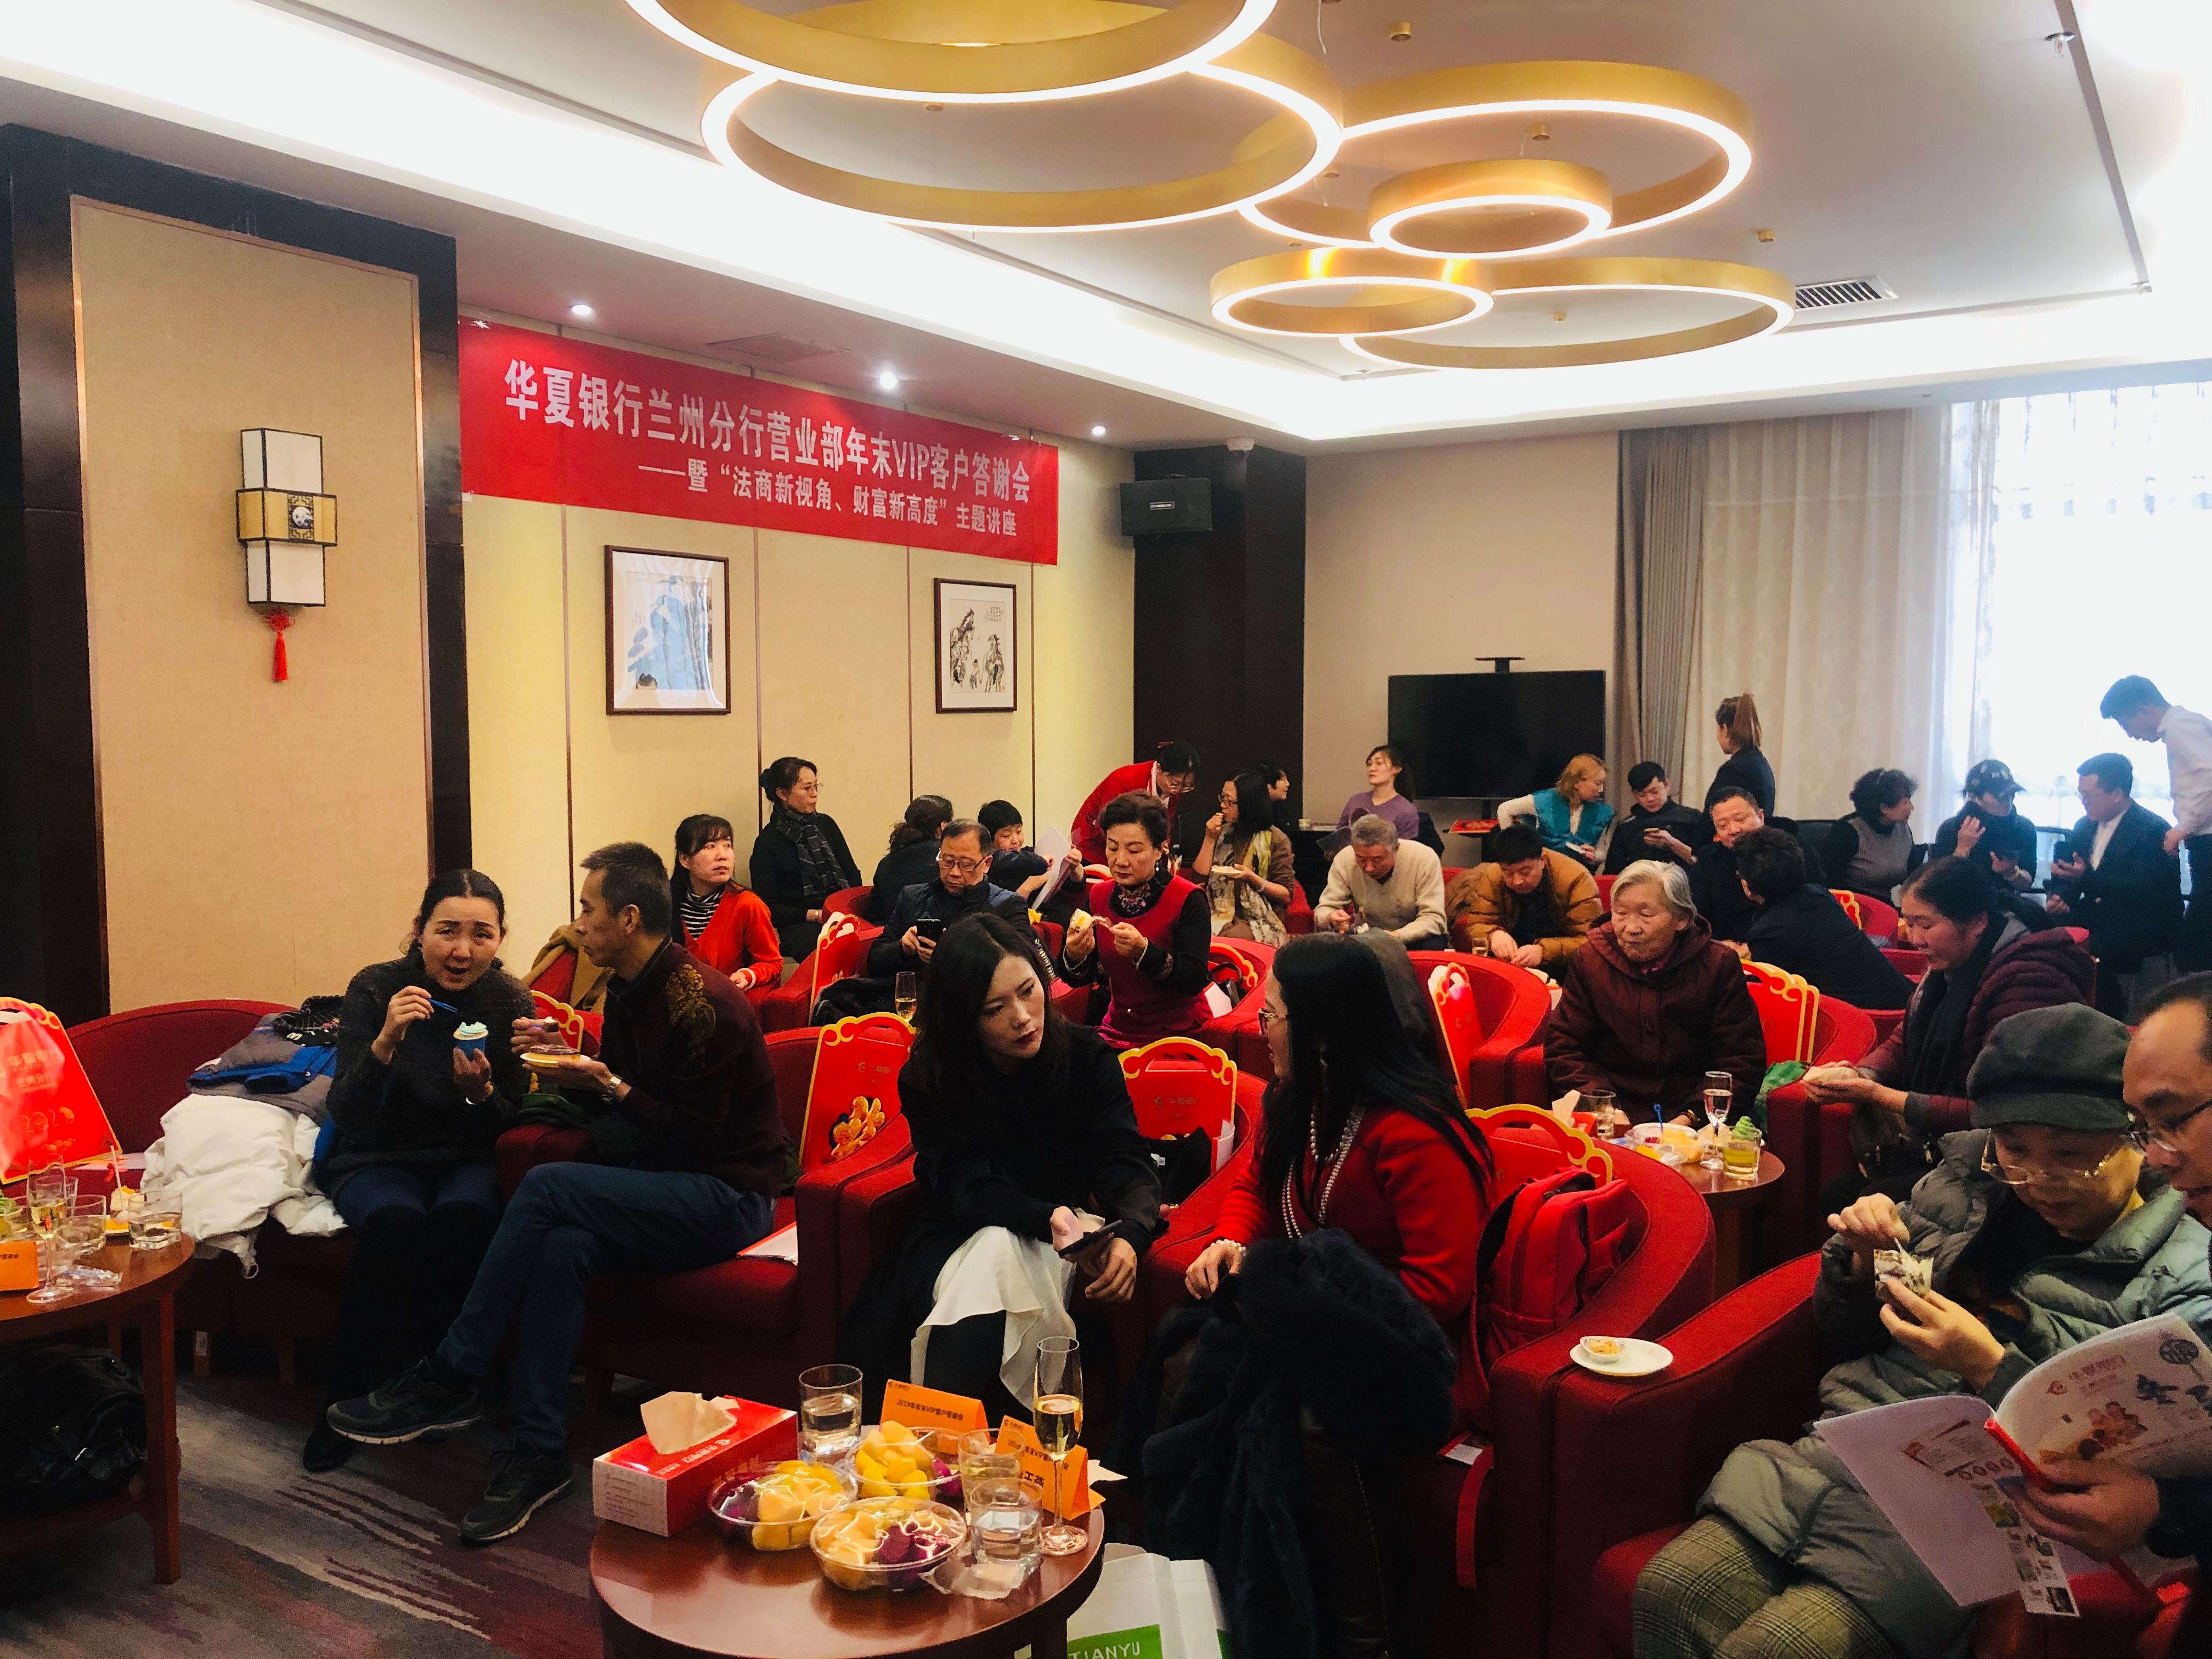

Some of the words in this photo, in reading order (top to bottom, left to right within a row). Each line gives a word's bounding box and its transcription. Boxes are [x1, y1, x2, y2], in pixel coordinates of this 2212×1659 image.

[504, 358, 1030, 504] 华夏银行兰州分行营业部年末VIP客户答谢会
[1068, 1641, 1141, 1659] TIANYU
